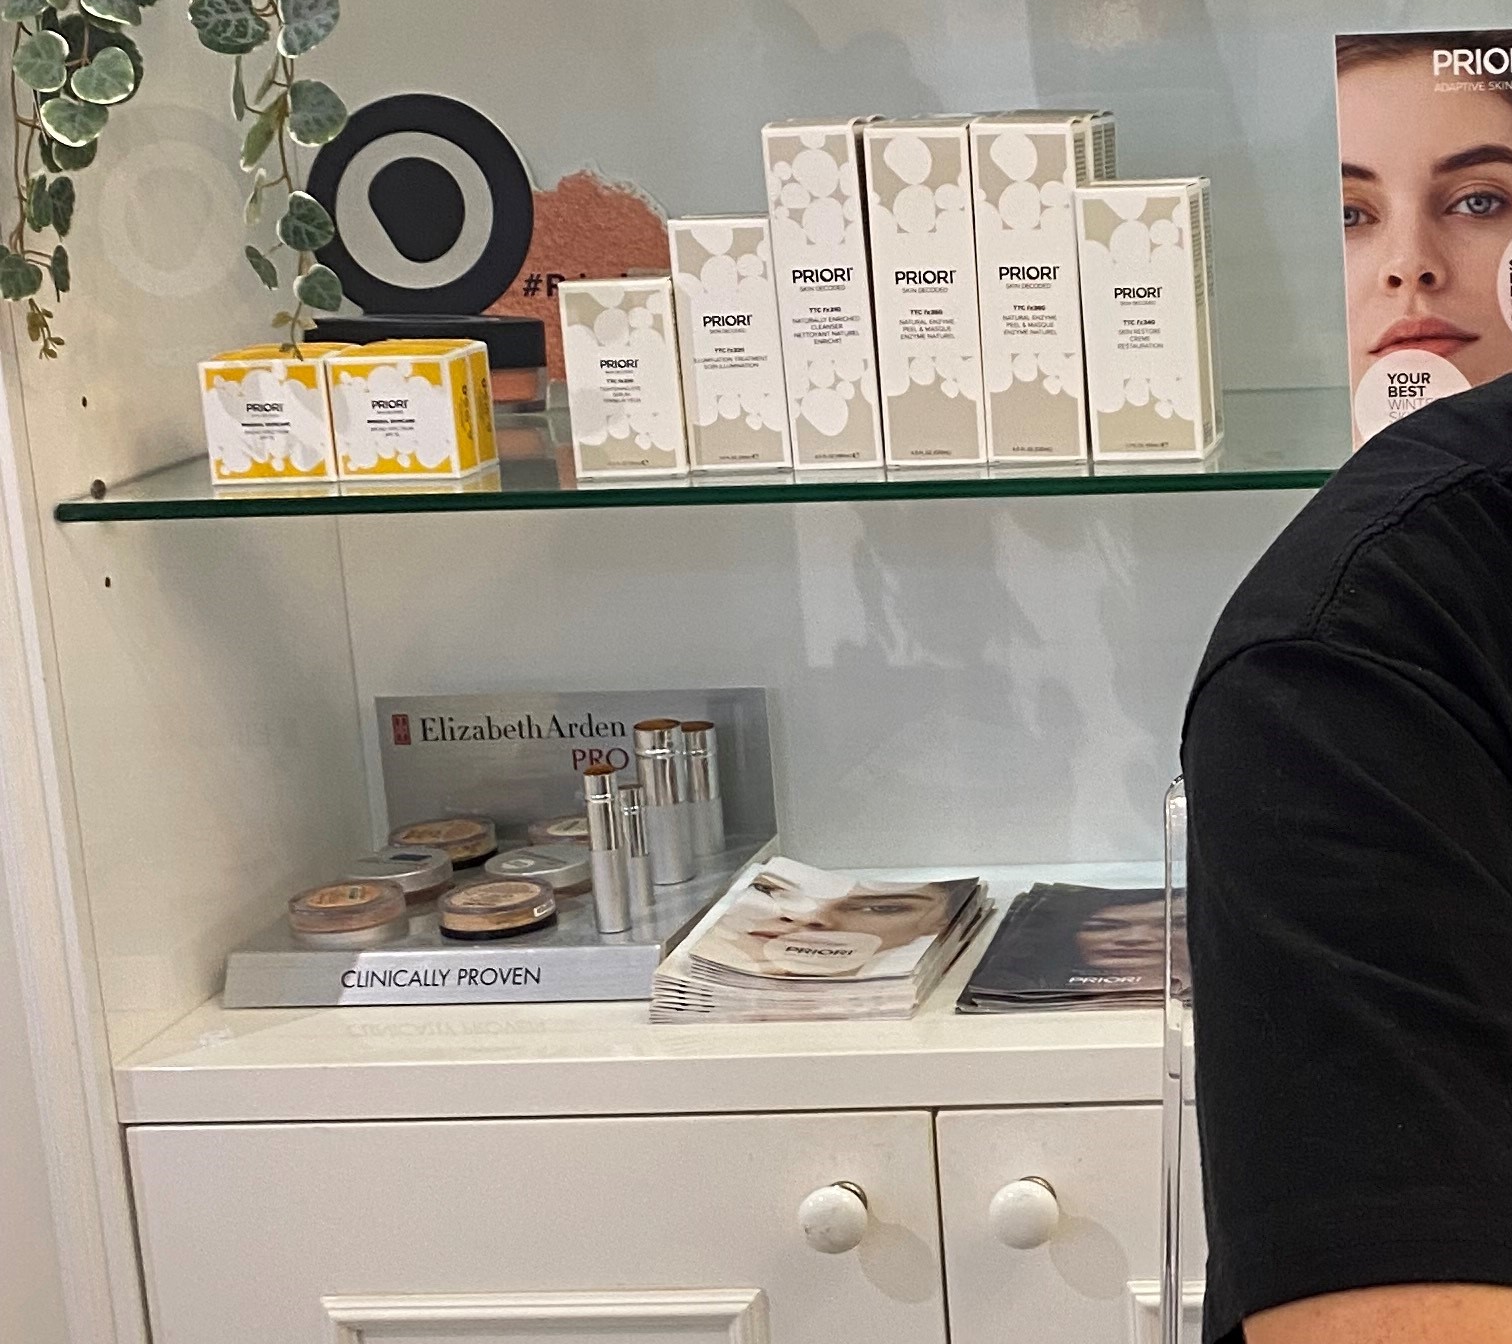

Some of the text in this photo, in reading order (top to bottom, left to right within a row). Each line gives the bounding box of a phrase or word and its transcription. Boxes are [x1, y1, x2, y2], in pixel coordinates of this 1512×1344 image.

[1434, 80, 1485, 92] ADAPTIVE
[792, 268, 851, 283] PRIORI
[895, 270, 954, 285] PRIORI
[999, 266, 1058, 280] PRIORI
[1114, 287, 1160, 299] PRIORI
[703, 315, 751, 327] PRIORI
[600, 359, 637, 369] PRIORI
[1386, 372, 1431, 385] YOUR
[1388, 385, 1426, 397] BEST
[246, 403, 284, 412] PRIORI
[371, 399, 409, 409] PRIORI
[419, 712, 628, 742] Elizabeth Arden
[571, 747, 629, 771] PRO
[785, 944, 854, 956] PRIORI
[341, 966, 541, 990] CLINICALLY PROVEN
[1068, 976, 1142, 985] PRIORI
